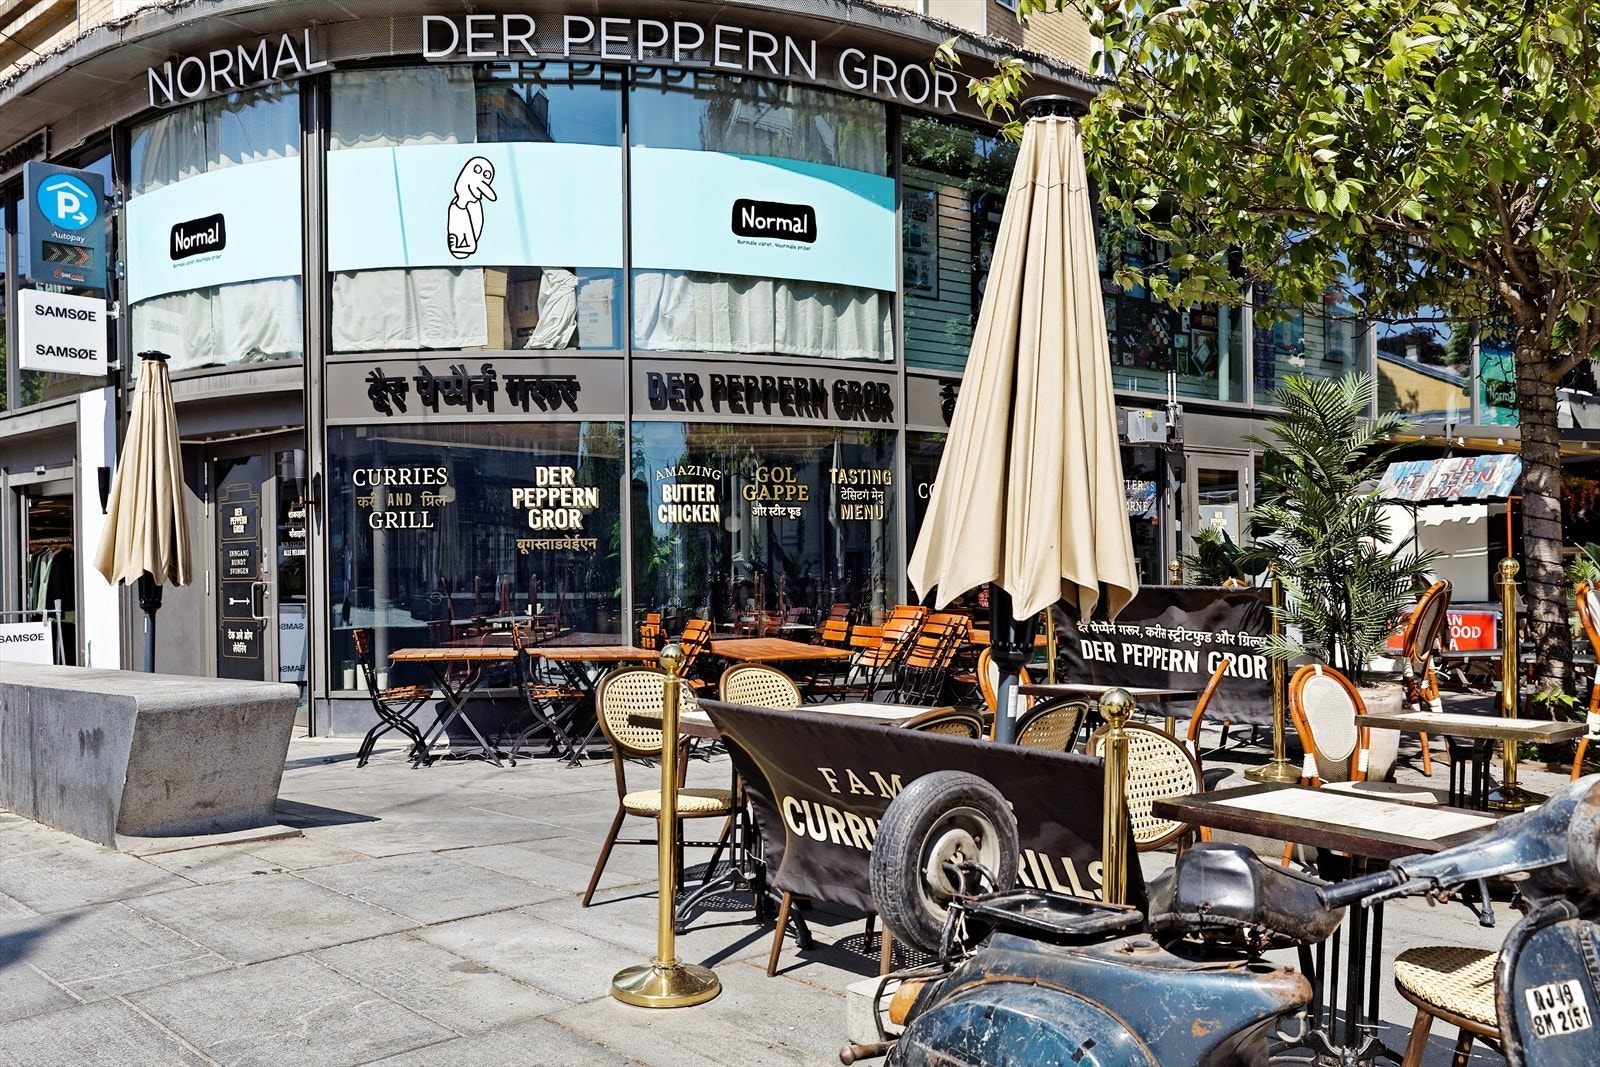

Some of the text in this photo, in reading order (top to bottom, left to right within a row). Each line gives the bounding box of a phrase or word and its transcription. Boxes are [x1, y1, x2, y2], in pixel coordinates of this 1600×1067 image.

[147, 28, 328, 106] NORMAL
[421, 14, 537, 59] DER
[562, 15, 817, 80] PEPPERN
[838, 47, 959, 113] GROR
[741, 205, 808, 234] Normal
[52, 231, 86, 243] Autopay
[174, 222, 219, 252] Normal
[35, 304, 97, 323] SAMSØE
[35, 343, 97, 361] SAMSØE
[646, 371, 893, 416] DER PEPPERN GROR
[352, 466, 448, 486] CURRIES
[534, 466, 576, 488] DER
[655, 465, 722, 482] AMAZING
[755, 466, 797, 484] GOL
[828, 468, 892, 485] TASTING
[387, 492, 412, 506] AND
[511, 487, 600, 510] PEPPERN
[662, 484, 716, 503] BUTTER
[742, 484, 810, 501] GAPPE
[368, 510, 434, 529] GRILL
[528, 508, 584, 530] GROR
[657, 503, 721, 524] CHICKEN
[840, 504, 884, 520] MENU
[0, 633, 45, 644] SAMSØE
[1449, 626, 1482, 639] OOD
[1080, 640, 1268, 680] DER PEPPERN GROR
[782, 795, 1103, 900] CURRI RILLS
[1533, 1006, 1591, 1036] 8M 2151
